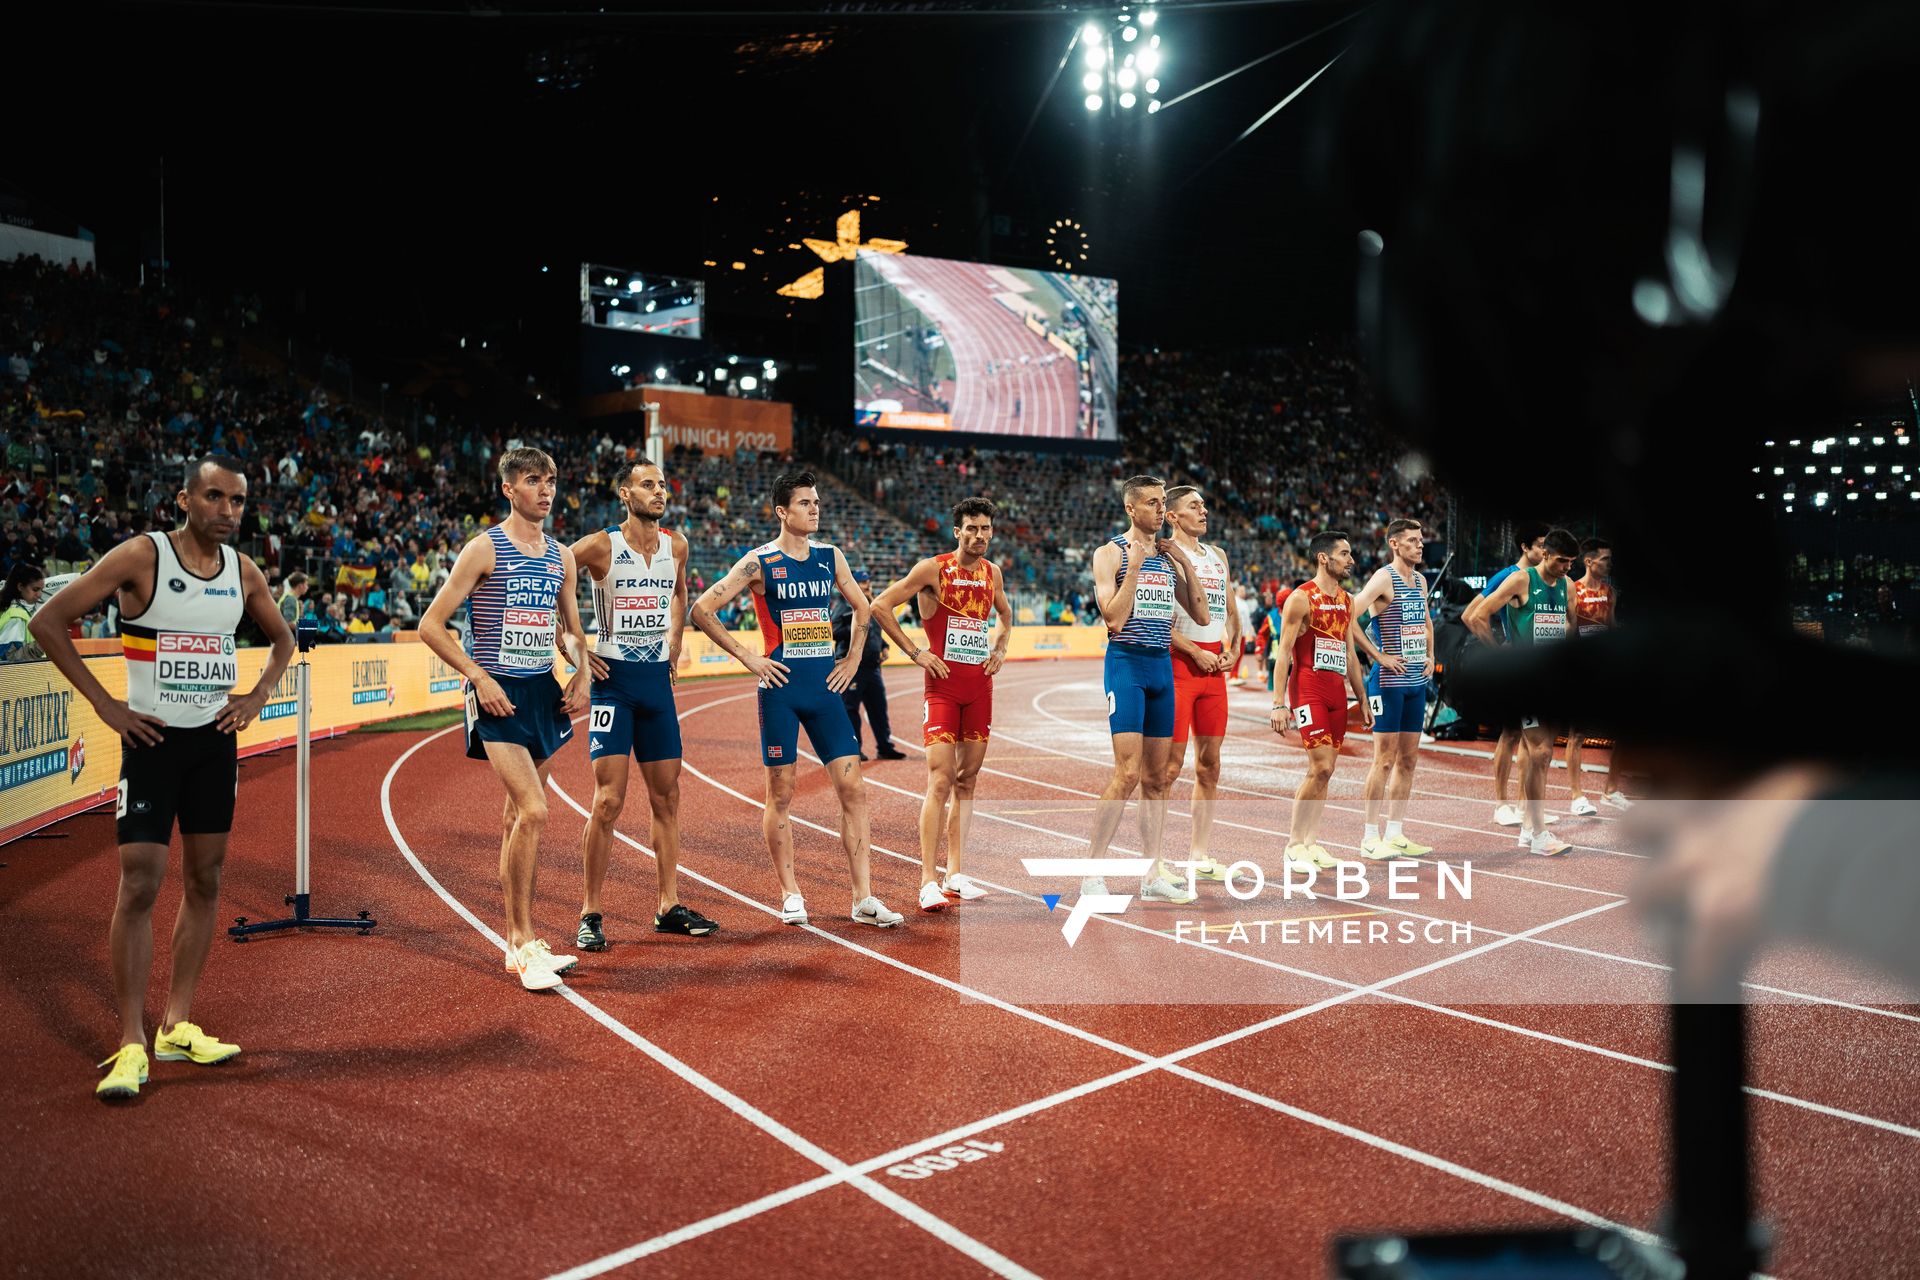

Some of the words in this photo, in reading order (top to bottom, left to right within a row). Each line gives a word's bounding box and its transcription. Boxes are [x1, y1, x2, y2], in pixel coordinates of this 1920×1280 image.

[659, 425, 729, 449] MUNICH
[735, 432, 777, 450] 2022
[45, 580, 69, 588] Canon
[507, 578, 561, 593] GREAT
[1137, 574, 1168, 584] SPAR
[1200, 579, 1219, 587] PAR
[204, 588, 228, 596] Allianz
[778, 580, 831, 599] NORWAY
[1136, 589, 1174, 603] GOURLEY
[615, 598, 657, 608] SPAR
[1207, 593, 1225, 605] ZMYS
[506, 611, 549, 624] SPAR
[783, 611, 820, 622] SPAR
[1137, 609, 1162, 617] MUNICH
[1535, 615, 1560, 623] SPAR
[621, 614, 666, 628] HABZ
[950, 619, 982, 630] SPAR
[504, 631, 554, 647] STONIER
[784, 626, 832, 640] INGEBRIGTSEN
[947, 633, 957, 646] G.
[161, 636, 220, 652] SPAR
[616, 635, 647, 645] MUNICH
[1317, 640, 1341, 650] SPAR
[786, 648, 815, 656] MUNICH
[818, 647, 830, 655] 2022
[947, 653, 975, 662] MUNICH
[503, 655, 537, 666] MUNICH
[1316, 652, 1346, 667] FONTES
[160, 660, 235, 680] DEBJANI
[161, 691, 206, 704] MUNICH
[353, 690, 386, 703] SWITZERLAND
[468, 697, 477, 717] 11
[1372, 699, 1379, 712] 4
[593, 710, 611, 728] 10
[1300, 710, 1307, 724] 5
[0, 700, 10, 756] E
[0, 752, 66, 787] WITZERLAND
[886, 1140, 1005, 1180] 1500
